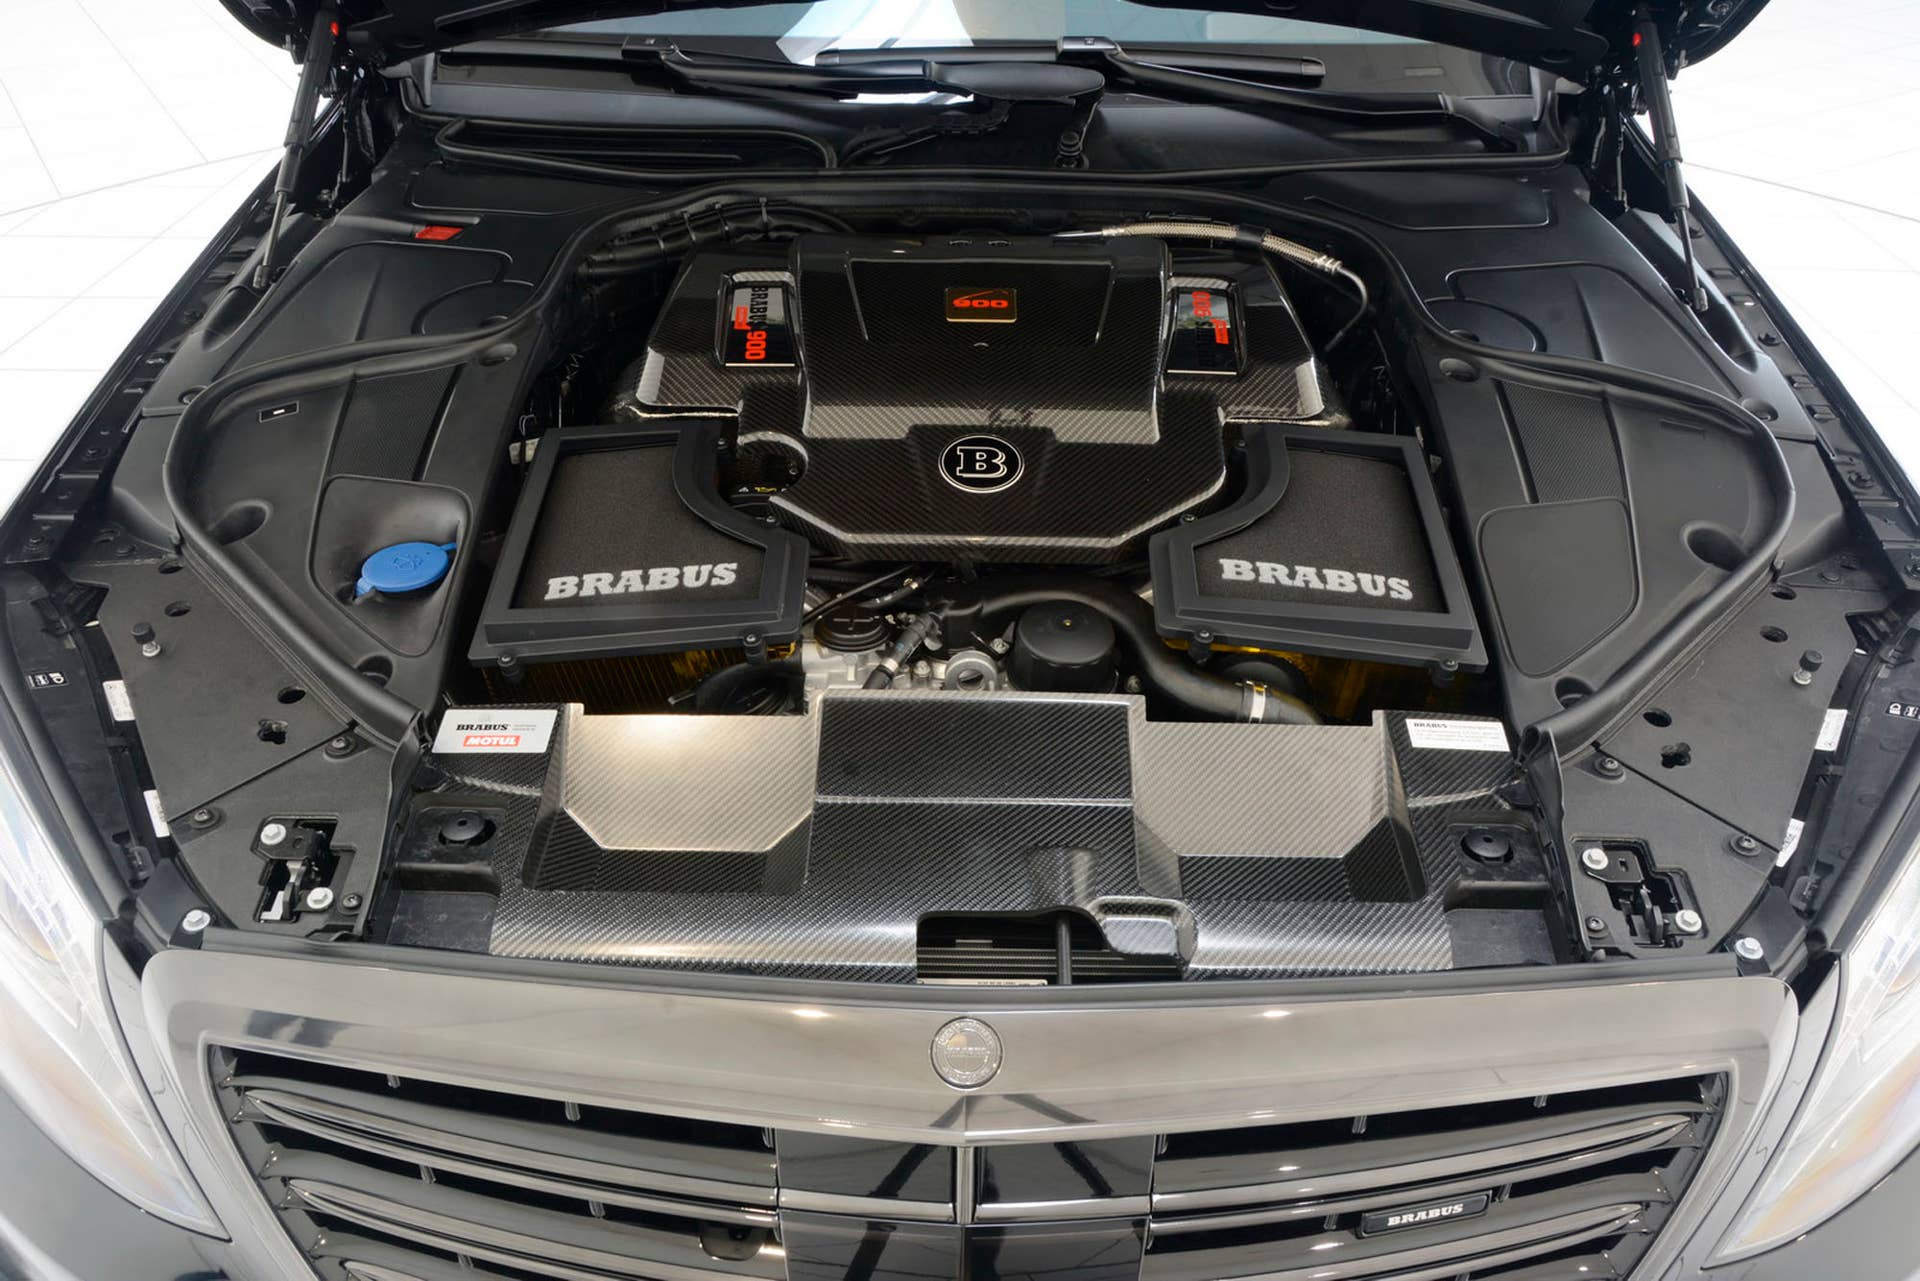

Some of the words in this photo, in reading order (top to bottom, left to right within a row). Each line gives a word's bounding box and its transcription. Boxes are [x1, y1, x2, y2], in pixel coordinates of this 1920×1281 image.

[745, 331, 768, 360] 900
[956, 446, 1008, 478] B
[544, 562, 738, 601] BRABUS
[1218, 558, 1414, 601] BRABUS
[456, 723, 509, 732] BRABUS
[466, 736, 517, 746] MOTUL
[1387, 1203, 1464, 1227] BRABUS
